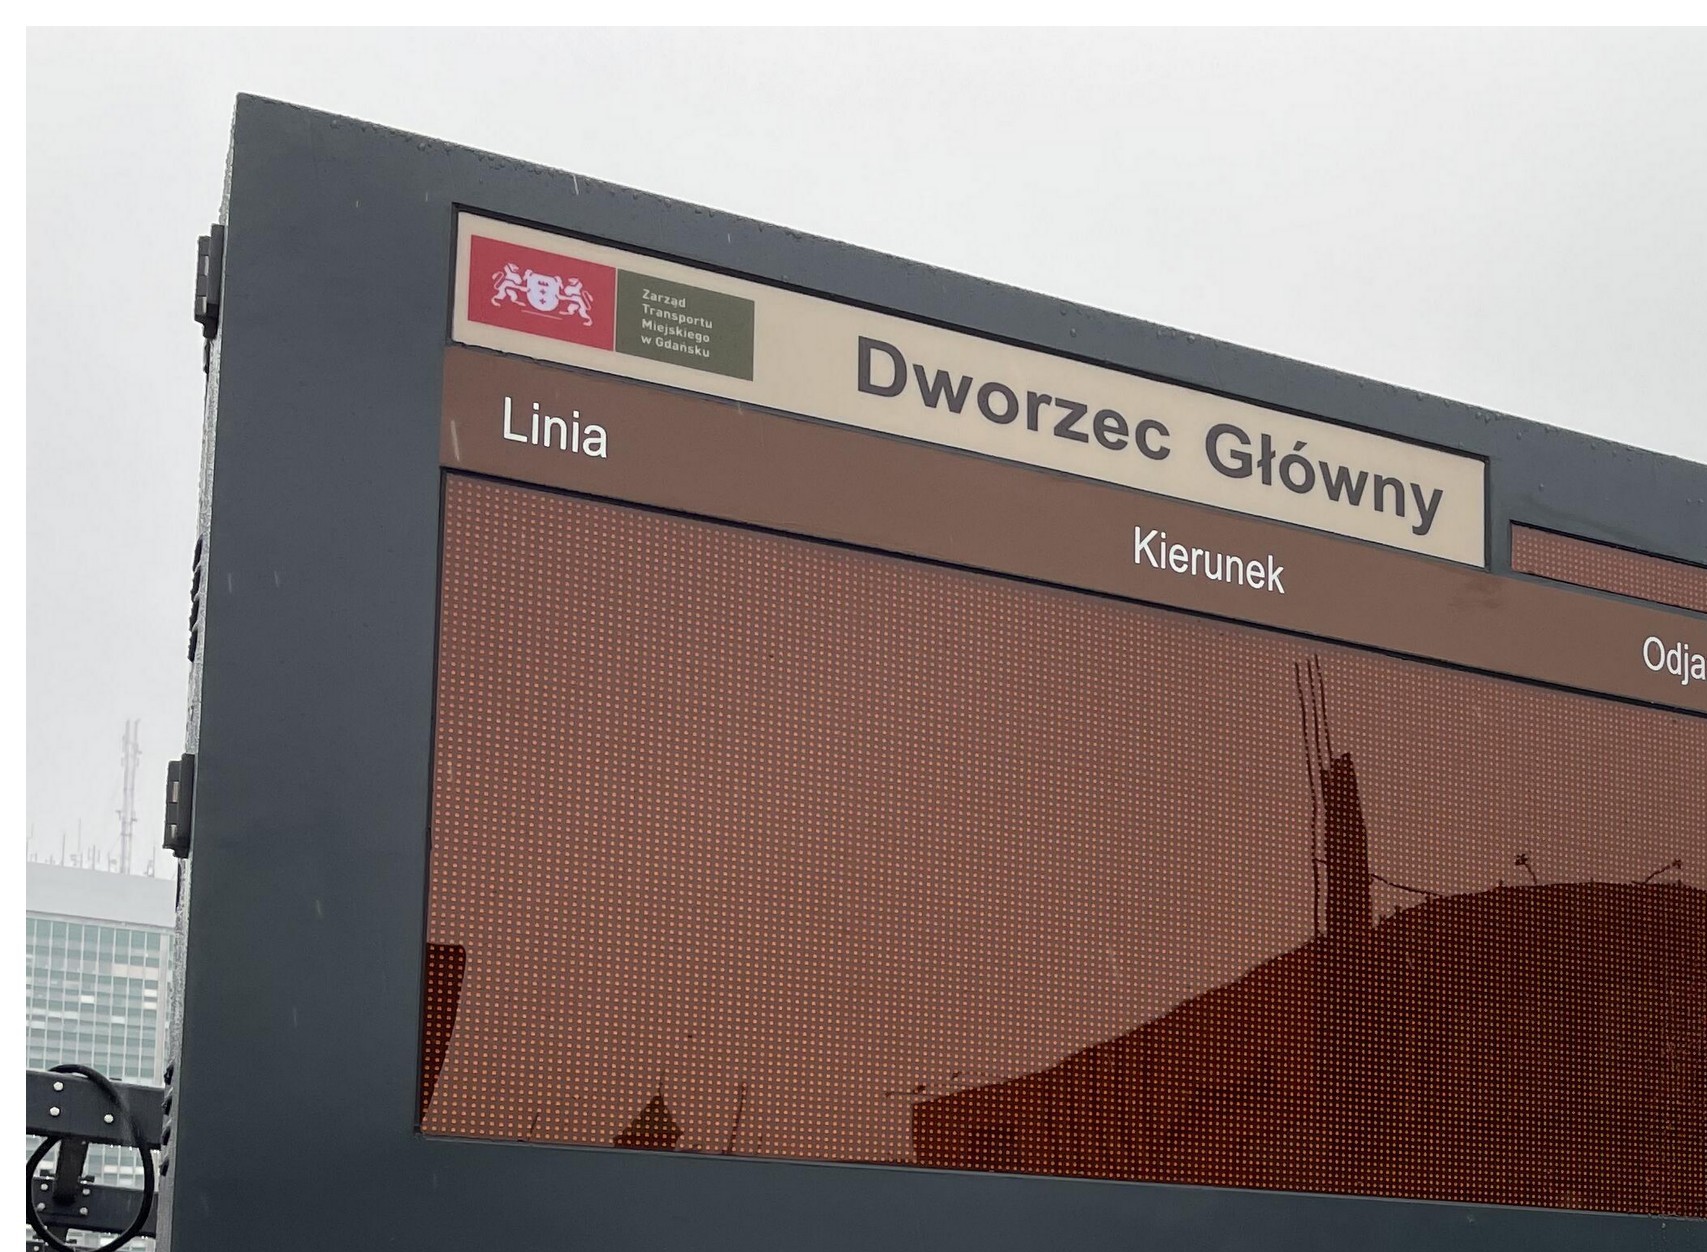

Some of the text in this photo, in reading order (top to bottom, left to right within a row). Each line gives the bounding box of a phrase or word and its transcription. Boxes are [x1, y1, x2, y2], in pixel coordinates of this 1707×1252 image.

[642, 288, 686, 308] Zarząd
[642, 303, 713, 329] Transportu
[641, 318, 710, 343] Miejskiego
[641, 335, 710, 358] w Gdańsku
[503, 396, 608, 459] Linia
[856, 335, 1444, 537] Dworzec Główny
[1133, 525, 1285, 594] Kierunek
